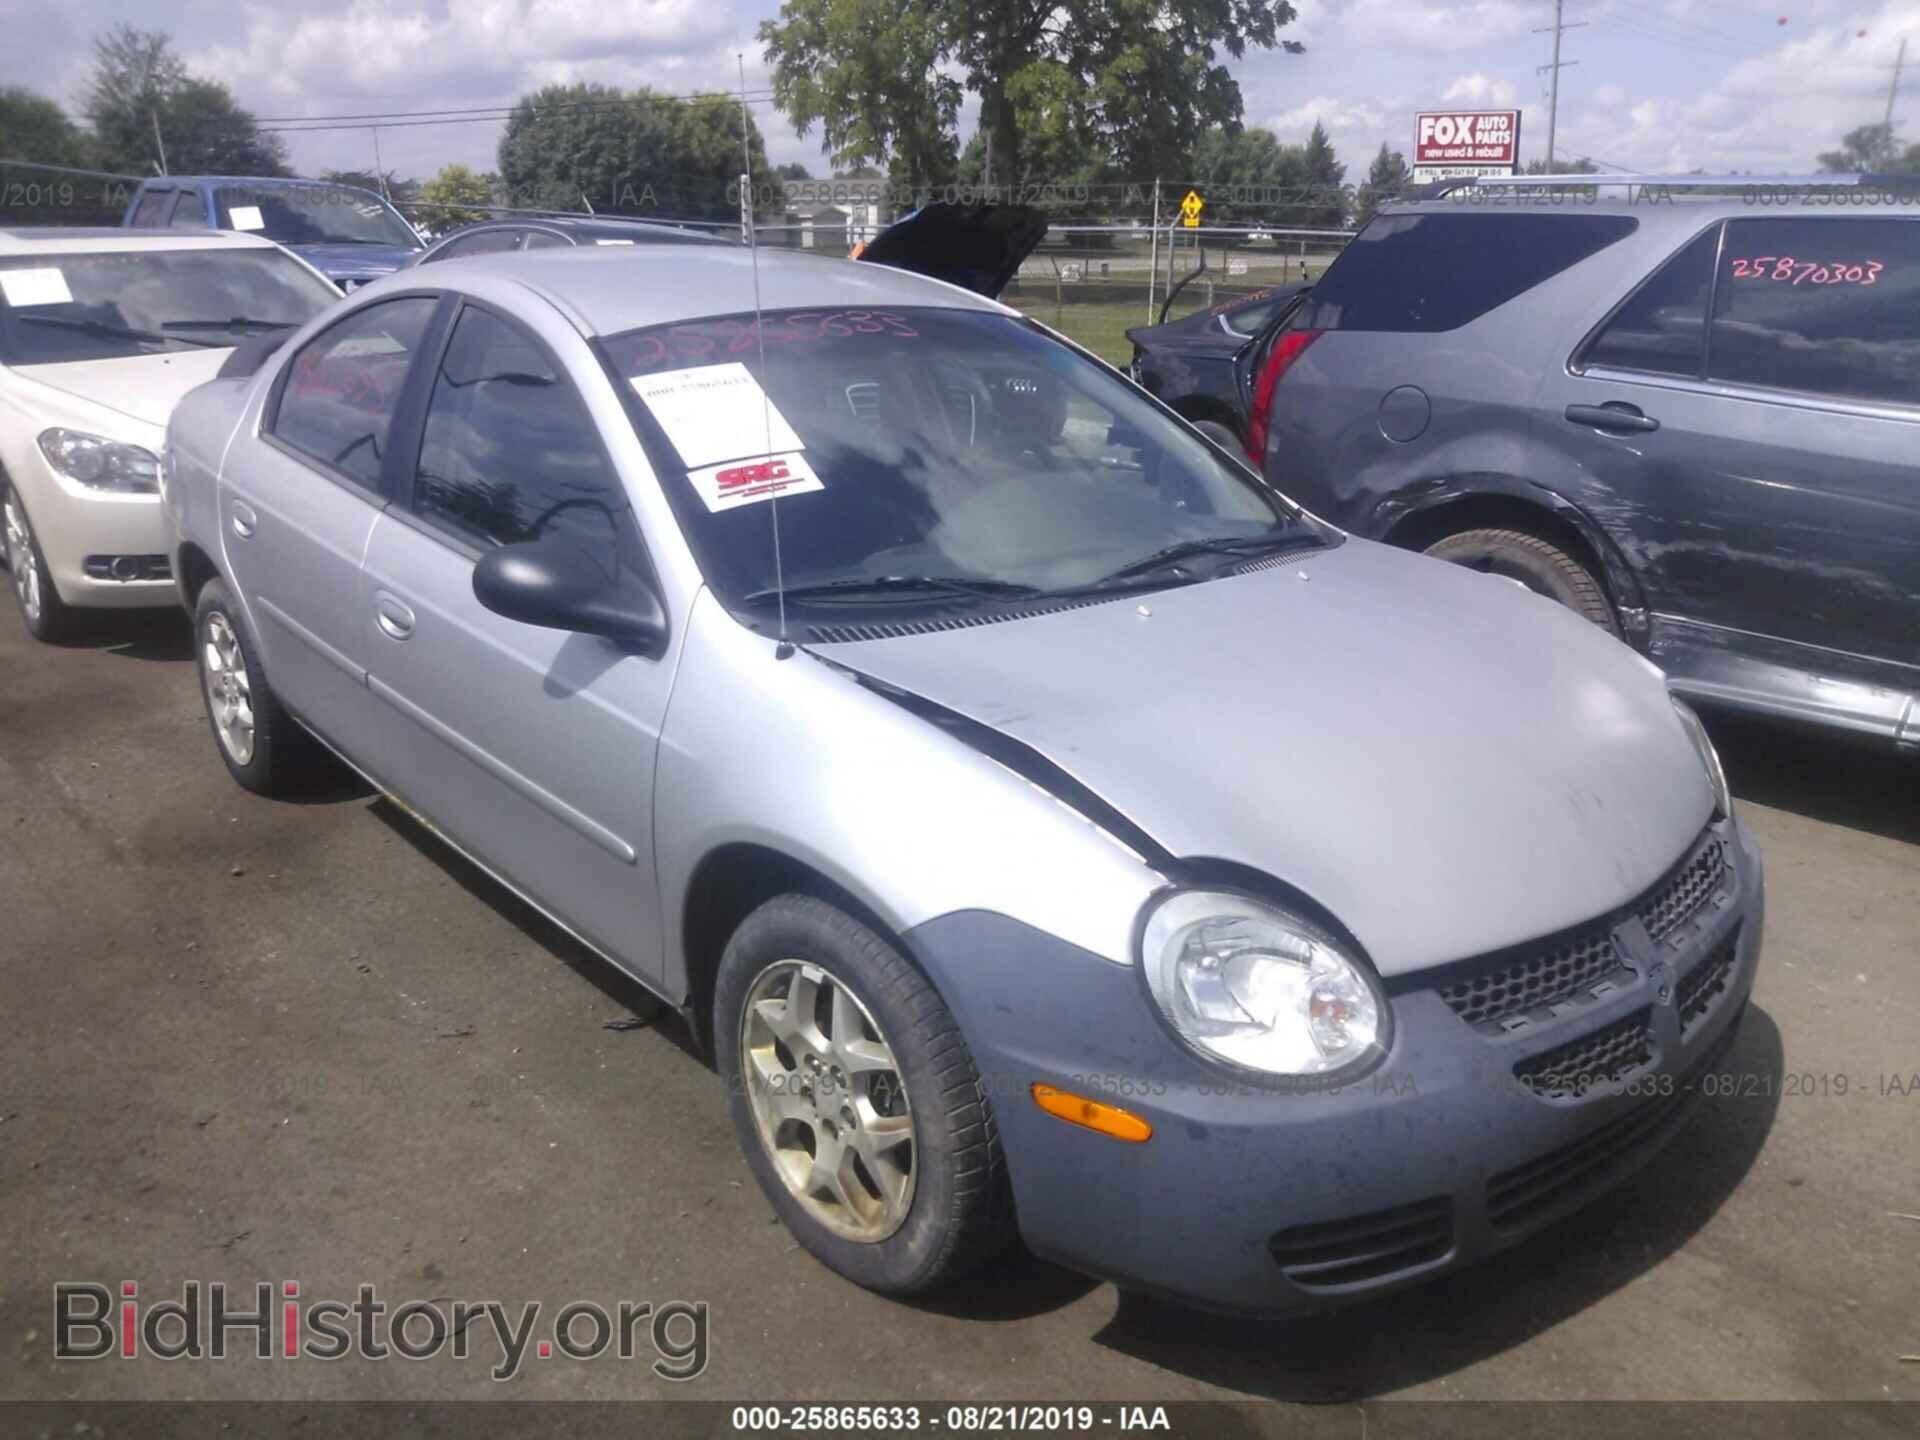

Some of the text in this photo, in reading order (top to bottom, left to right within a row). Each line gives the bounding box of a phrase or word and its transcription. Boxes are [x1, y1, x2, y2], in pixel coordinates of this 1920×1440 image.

[1420, 116, 1474, 145] FOX
[1476, 115, 1508, 130] AUTO
[1475, 131, 1511, 145] PARTS
[1732, 256, 1883, 285] 25870303
